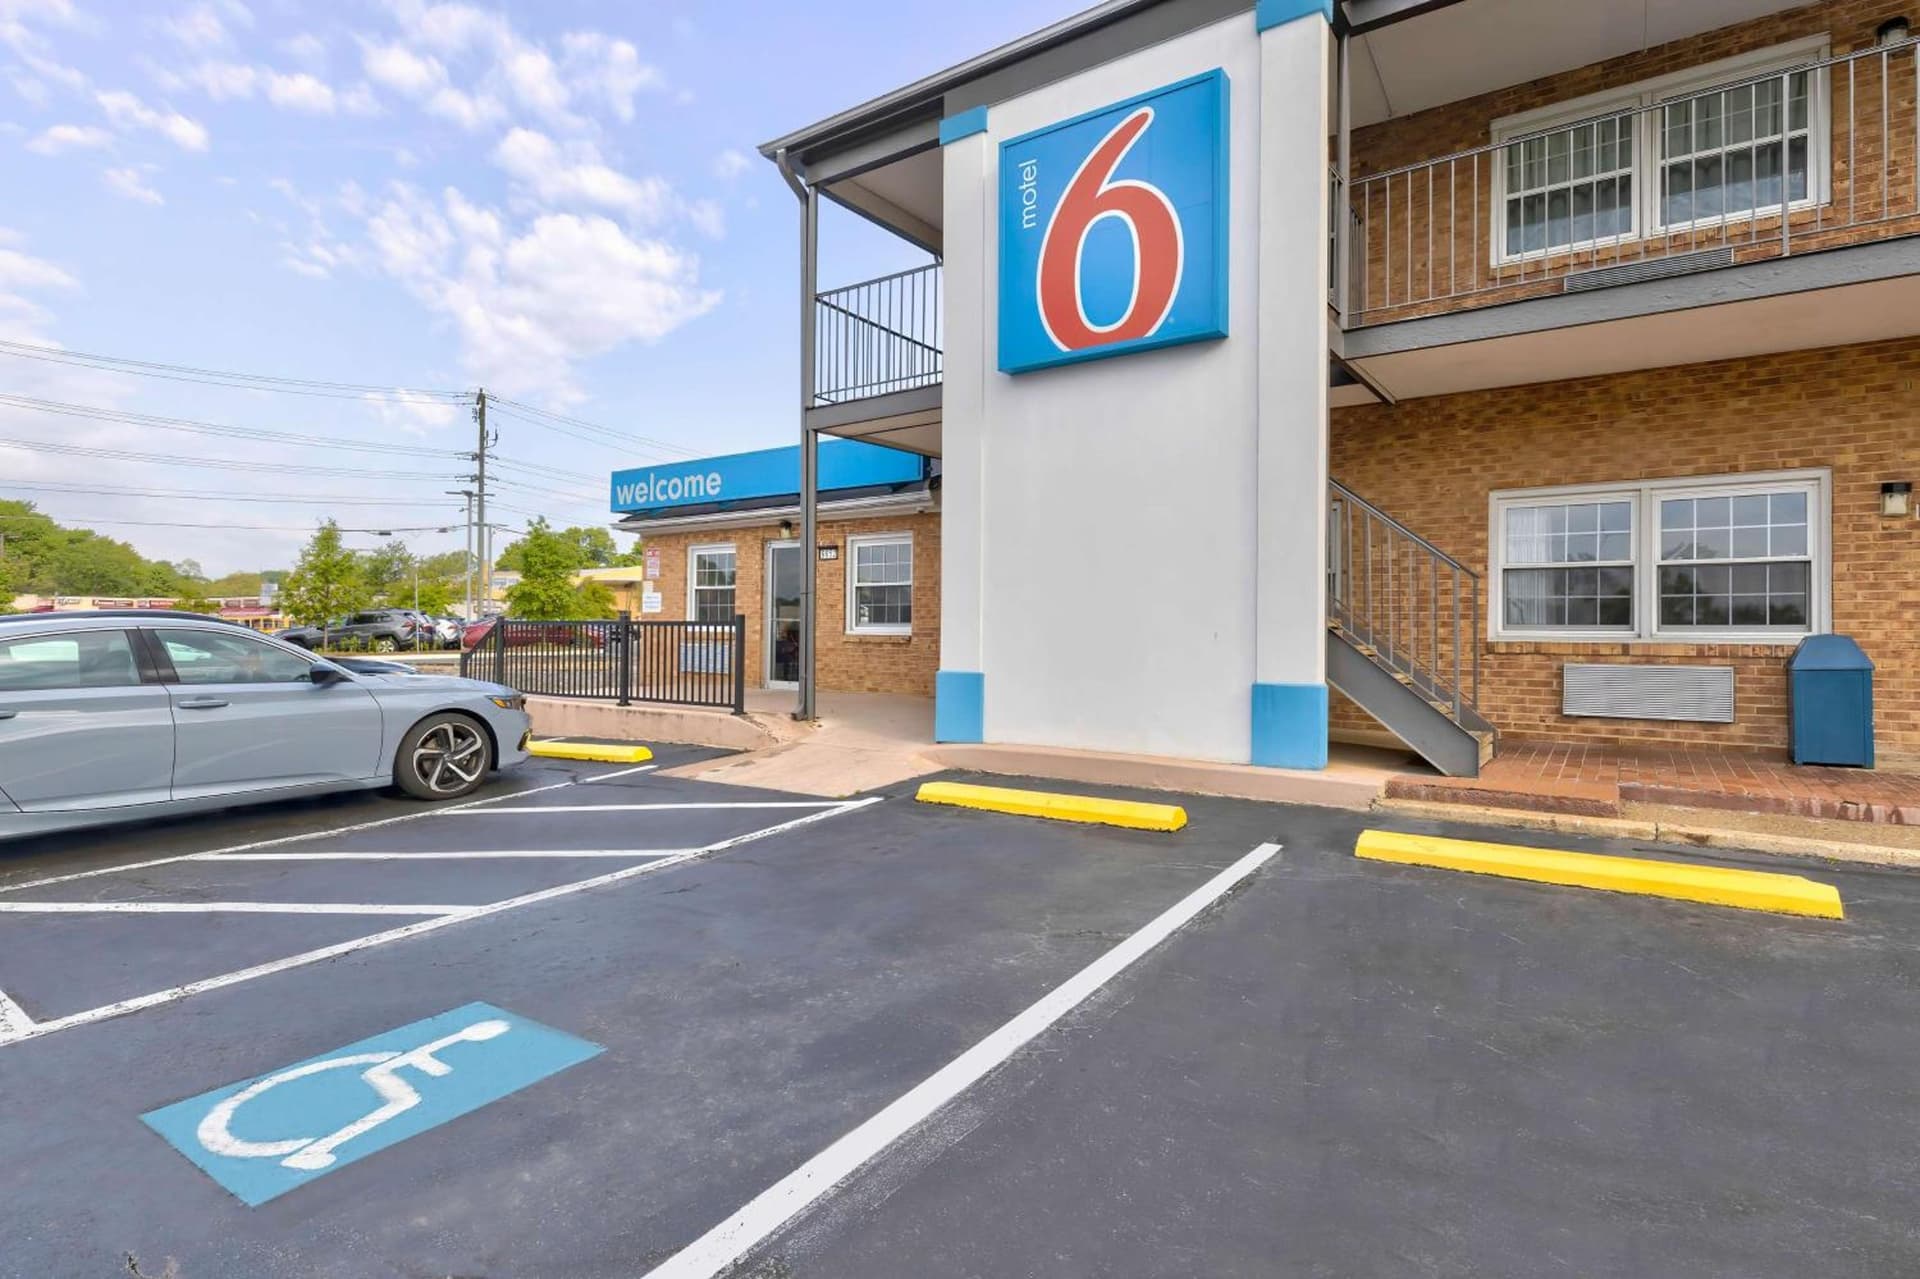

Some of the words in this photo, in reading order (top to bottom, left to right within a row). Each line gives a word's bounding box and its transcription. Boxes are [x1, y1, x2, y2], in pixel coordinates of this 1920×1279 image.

[1018, 158, 1037, 229] motel
[1036, 106, 1184, 352] 6
[616, 472, 722, 505] welcome
